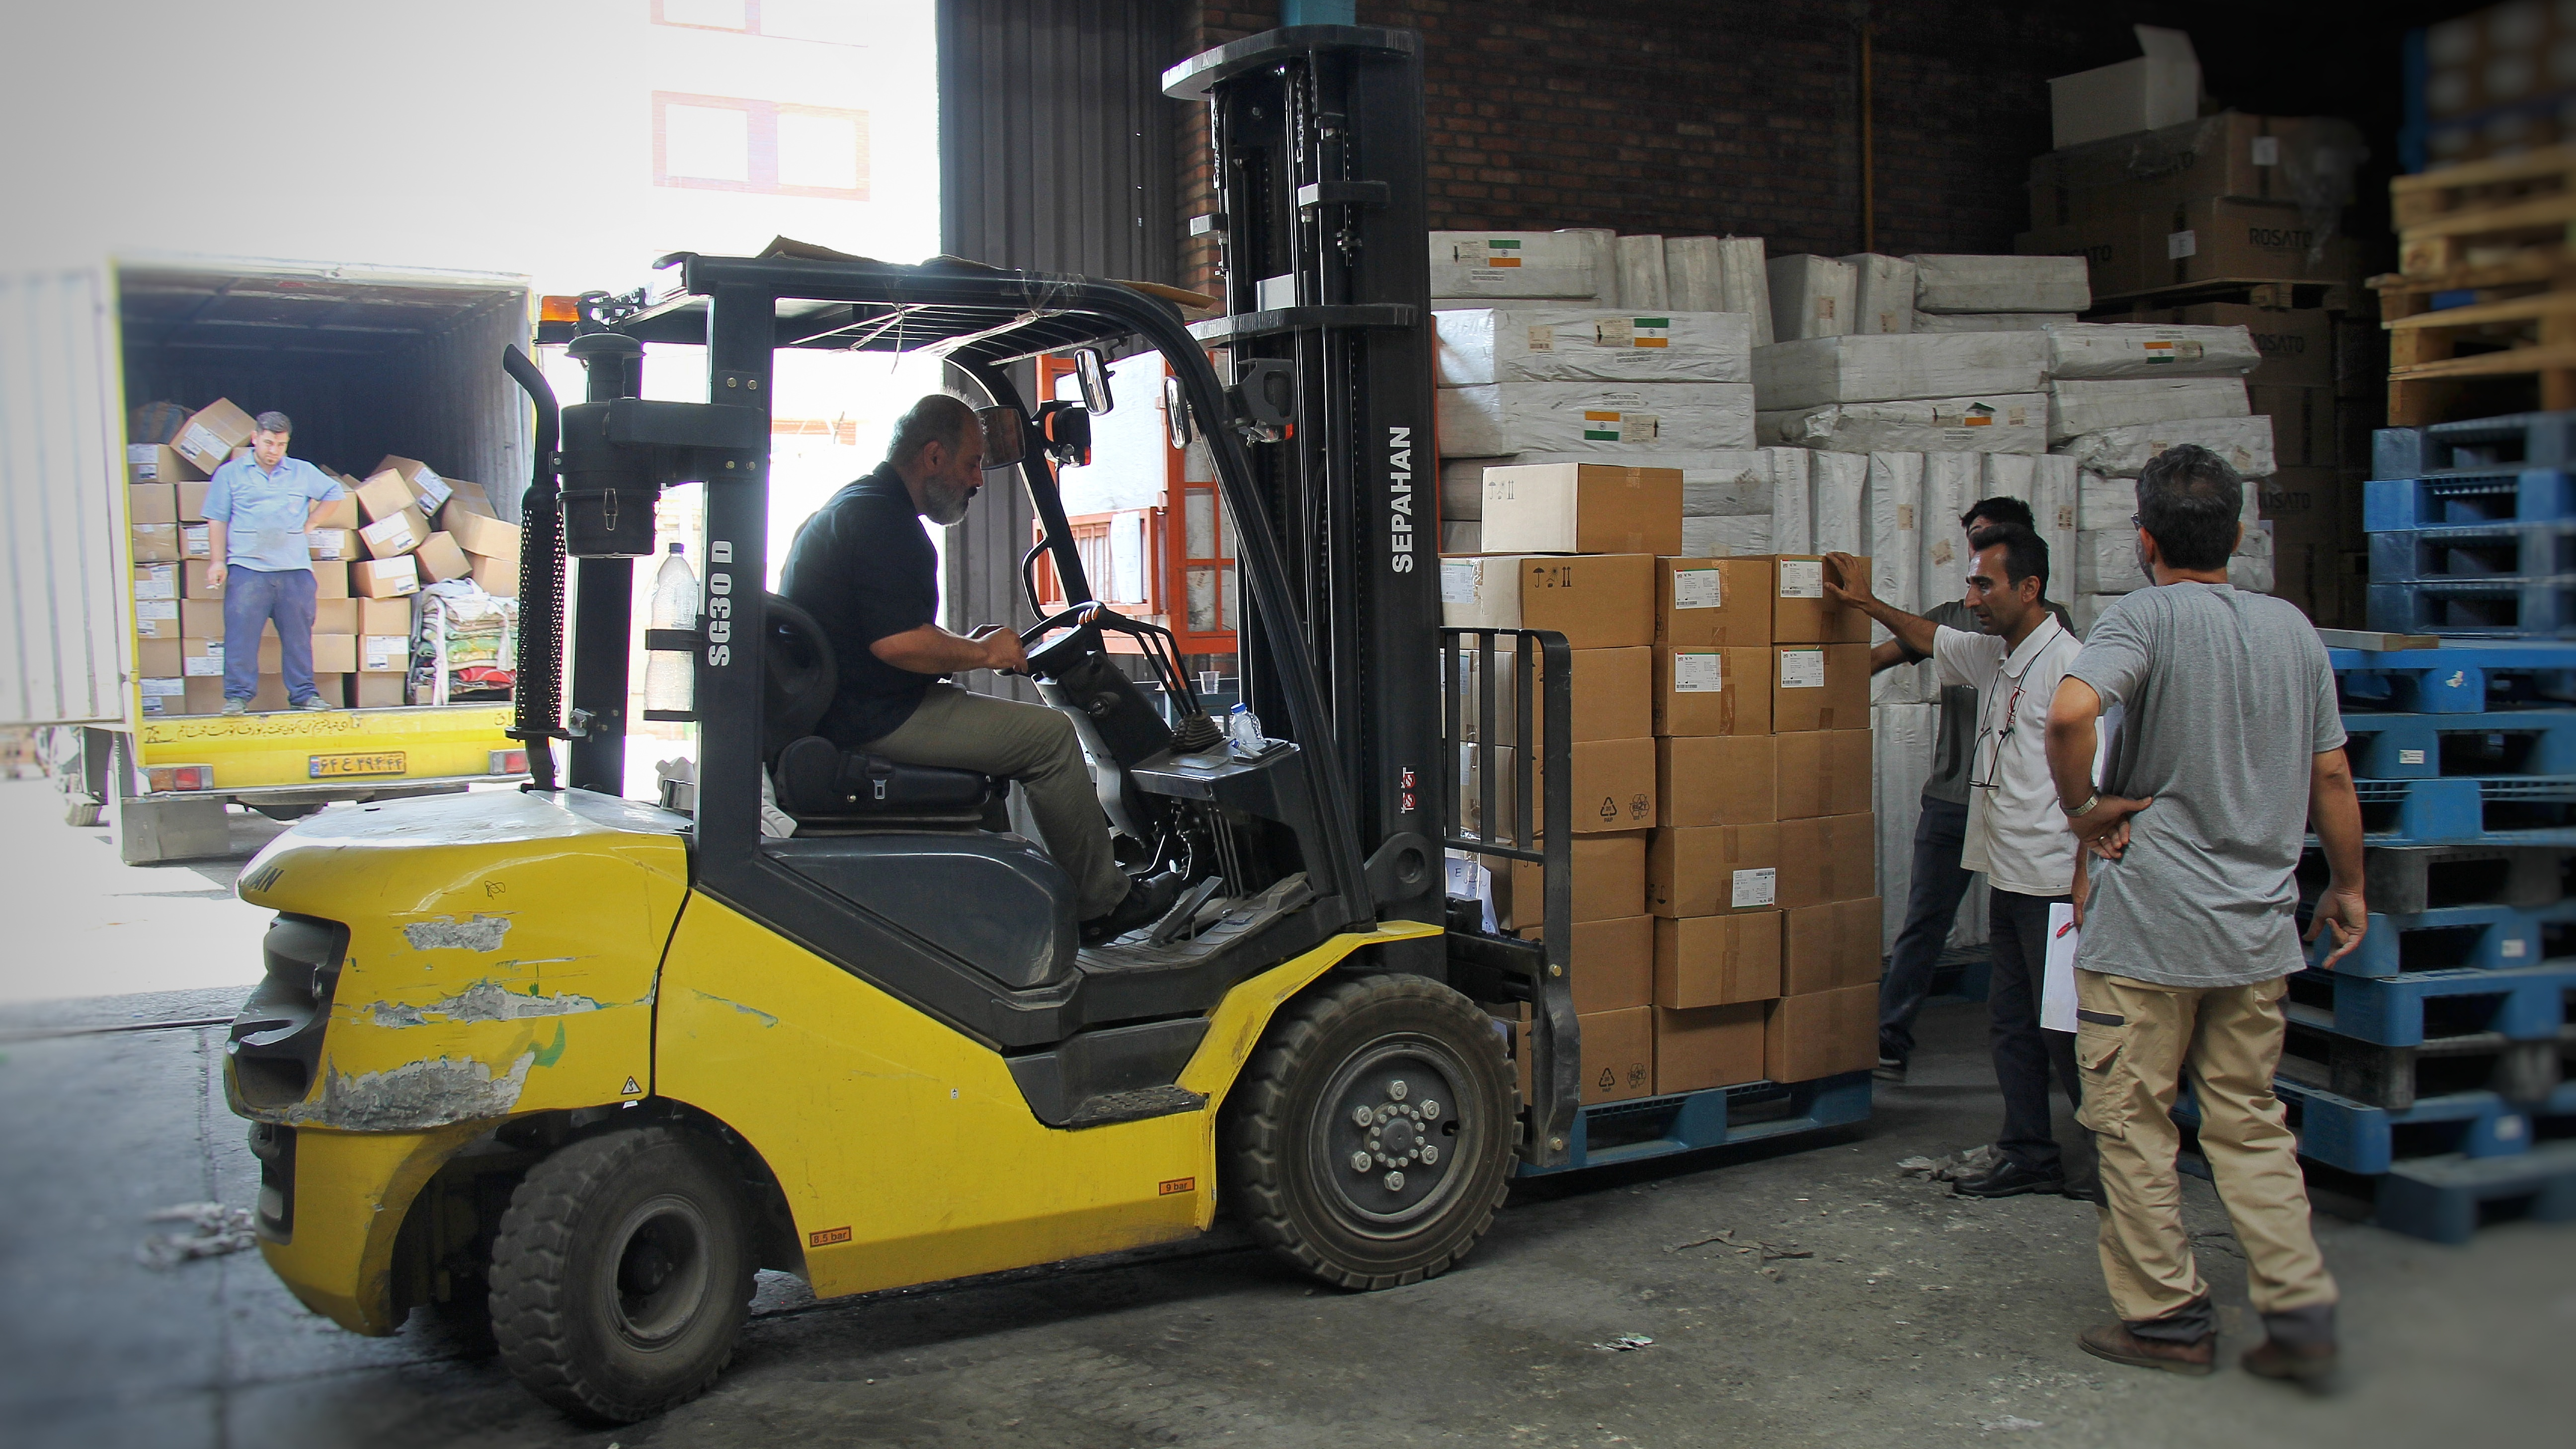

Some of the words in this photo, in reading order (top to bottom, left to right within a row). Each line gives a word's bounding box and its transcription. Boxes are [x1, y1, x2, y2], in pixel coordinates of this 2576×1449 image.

[2250, 228, 2312, 248] ROSATO
[1389, 427, 1413, 573] SEPAHAN
[711, 541, 732, 564] D
[708, 573, 732, 666] SG30
[830, 1232, 847, 1241] bar
